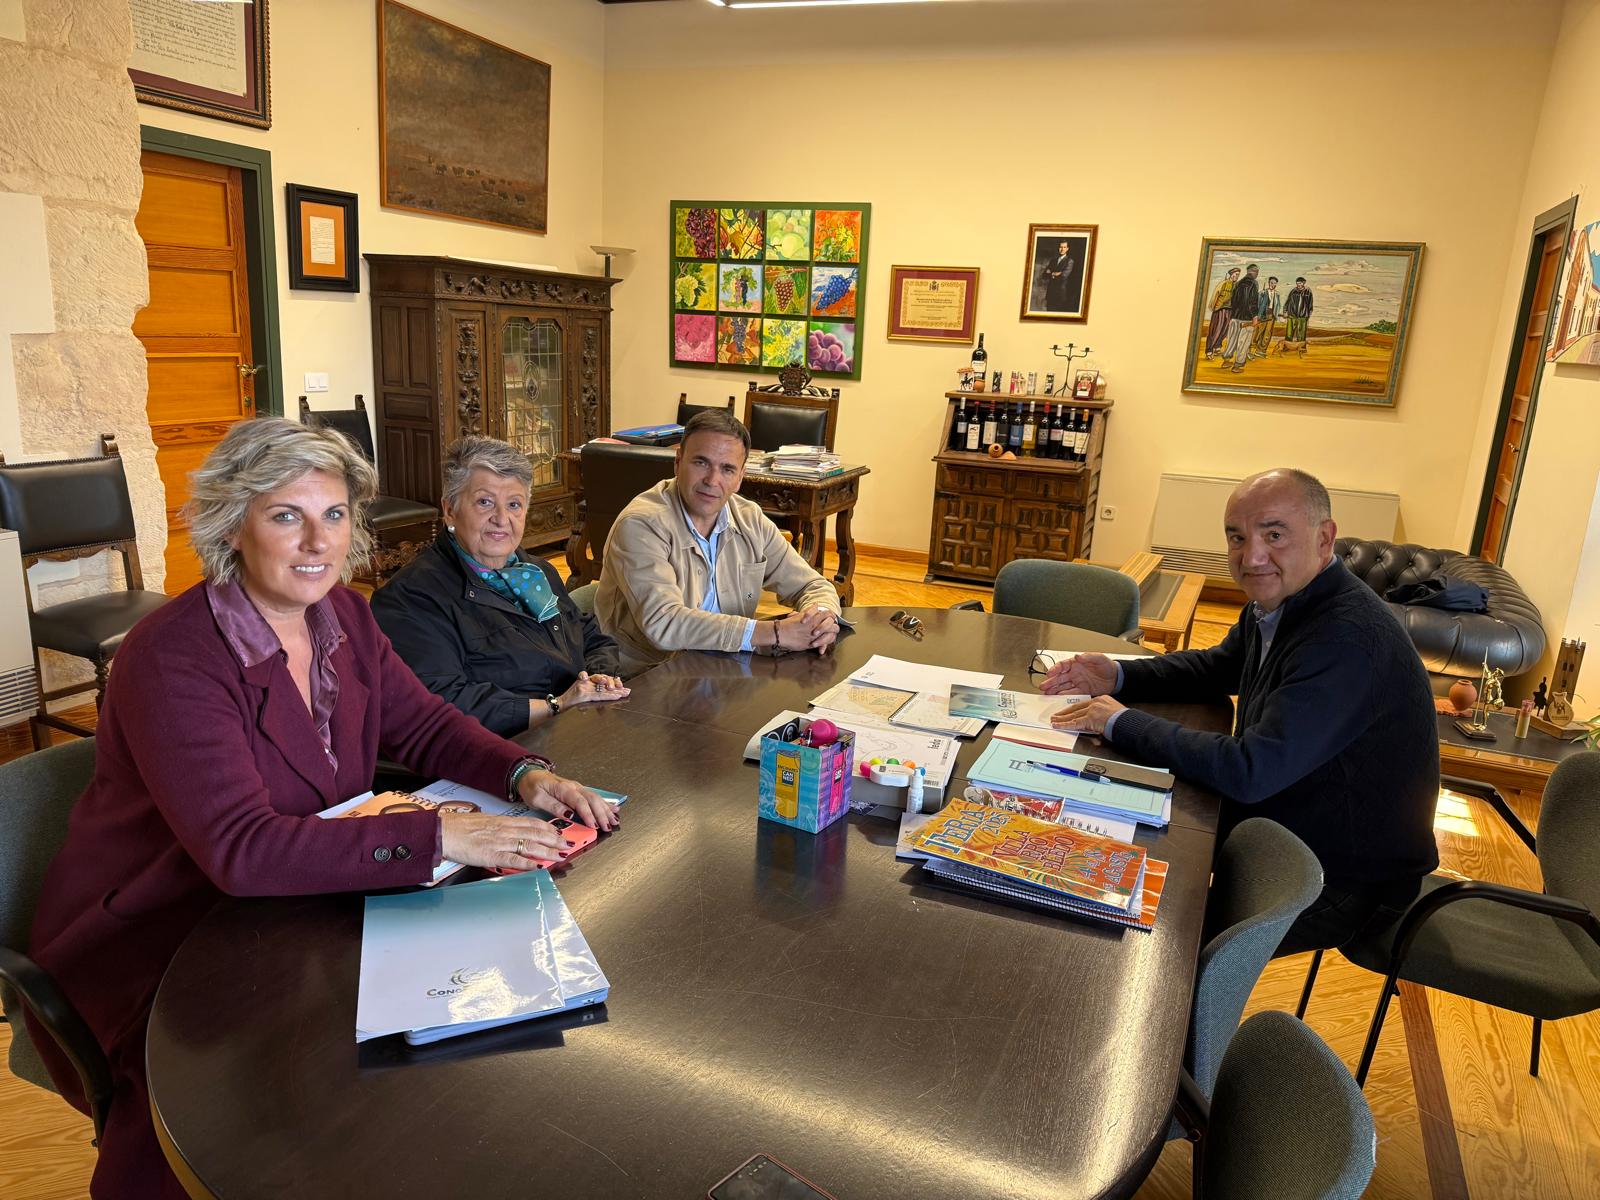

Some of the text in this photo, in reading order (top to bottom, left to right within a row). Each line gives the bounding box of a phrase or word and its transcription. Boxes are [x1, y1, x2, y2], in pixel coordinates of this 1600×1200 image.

[924, 809, 986, 854] FERIA
[981, 810, 1011, 835] 2025
[991, 829, 1030, 857] VILLA
[1020, 837, 1048, 860] RRO
[1041, 836, 1075, 871] BLEDO
